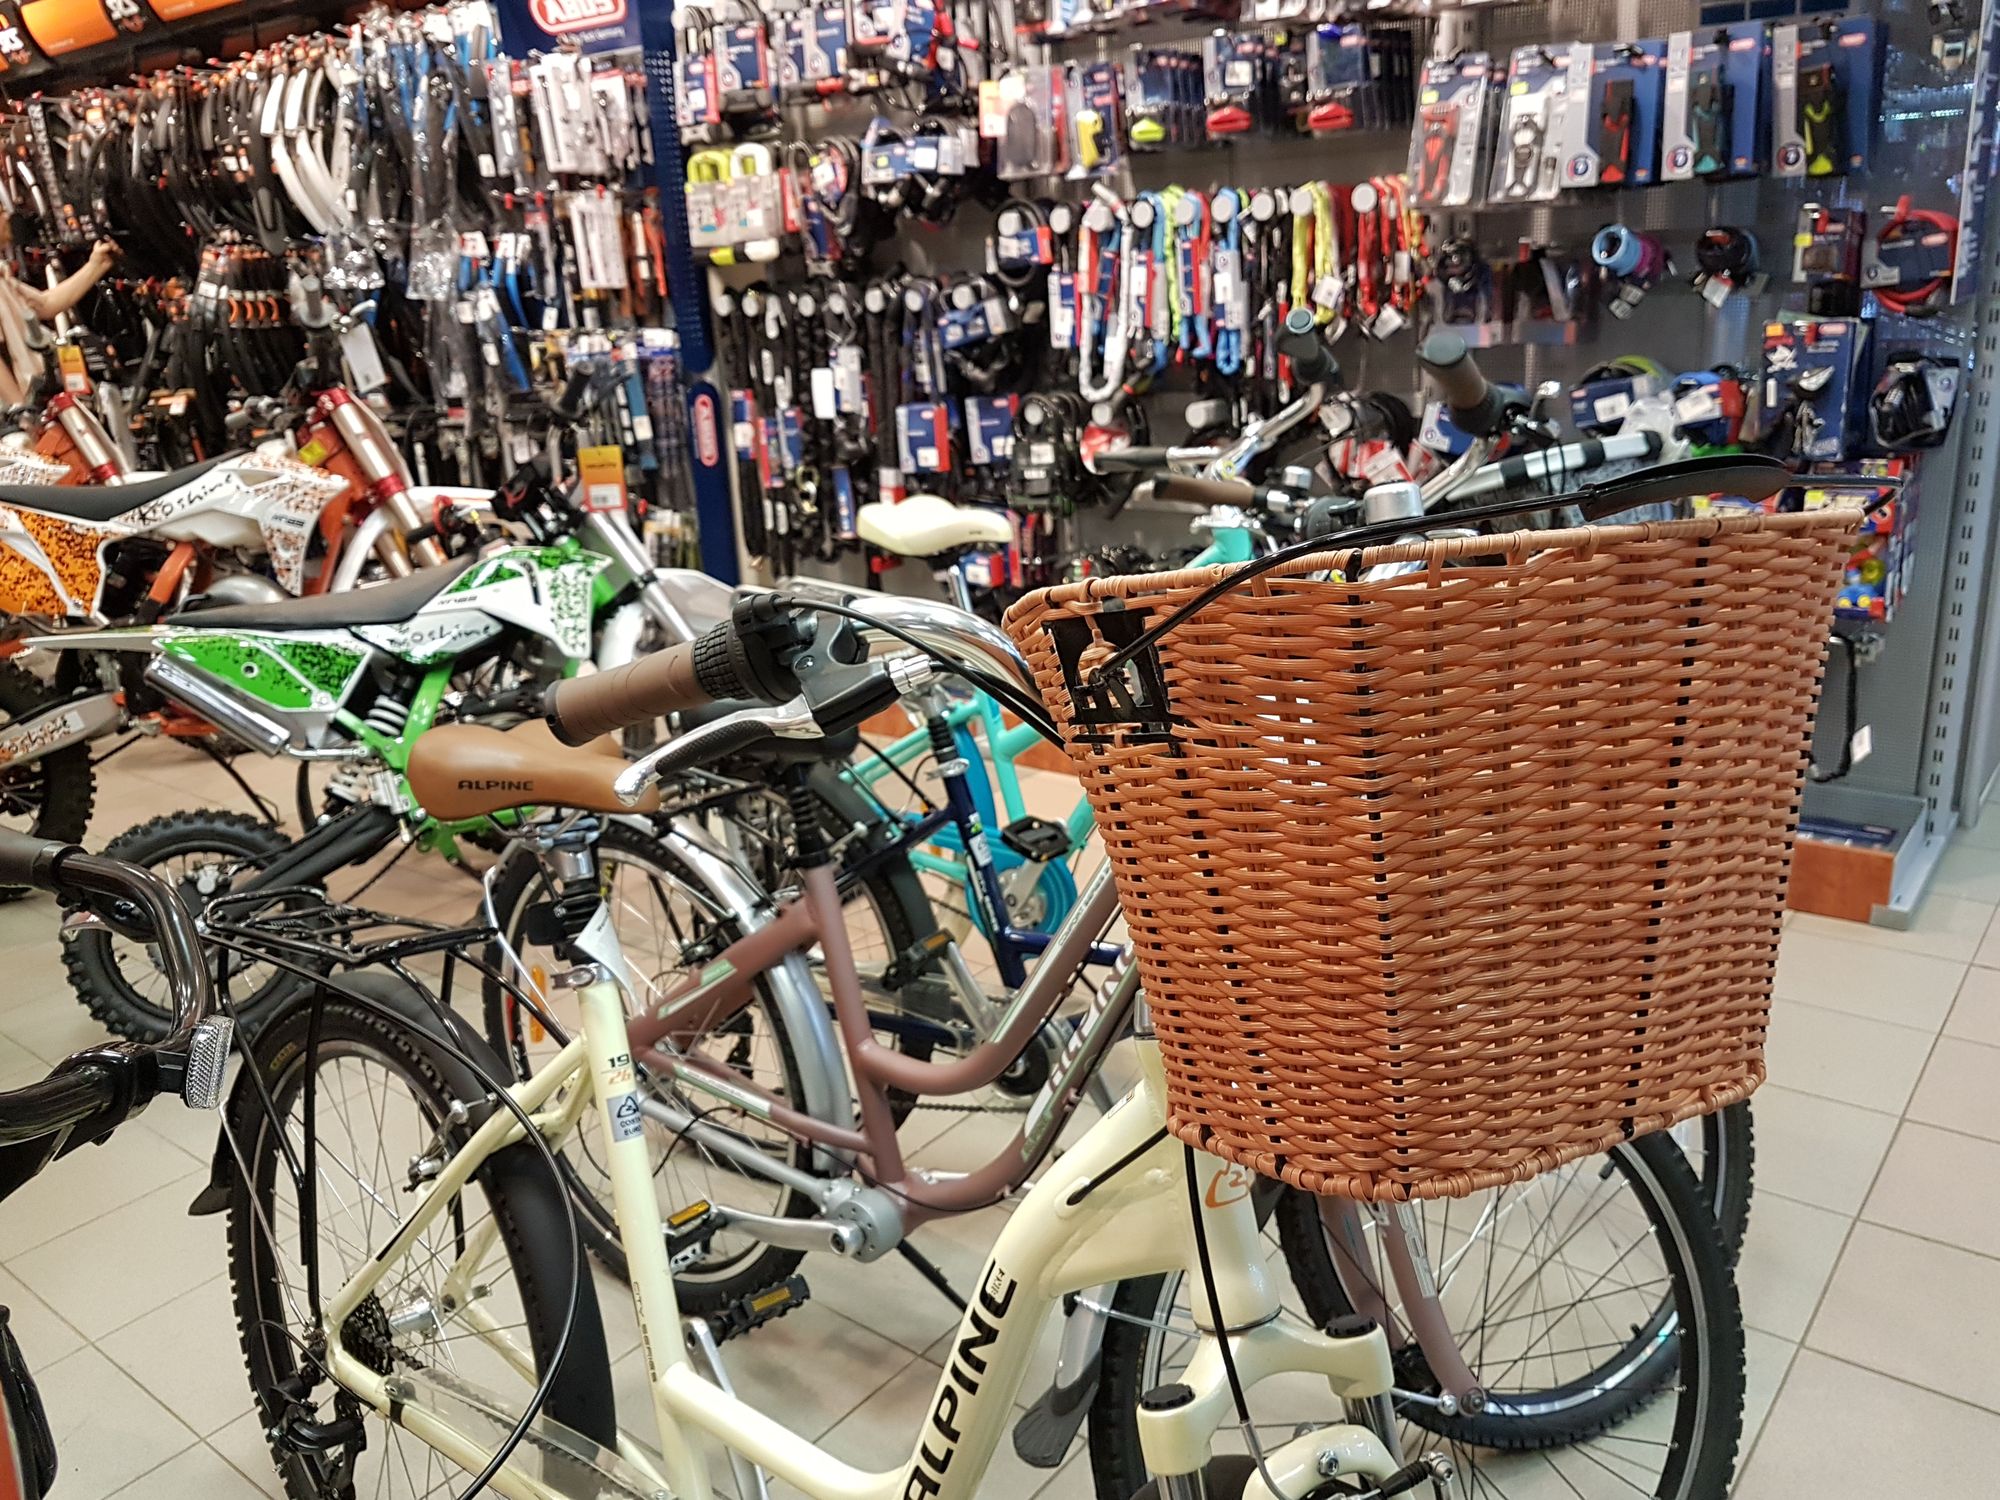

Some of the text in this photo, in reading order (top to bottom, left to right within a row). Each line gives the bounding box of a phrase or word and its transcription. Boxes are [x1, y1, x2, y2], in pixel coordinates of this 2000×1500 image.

[457, 779, 535, 792] ALPINE
[607, 1053, 630, 1069] 19
[903, 1257, 1018, 1500] ALPINE
